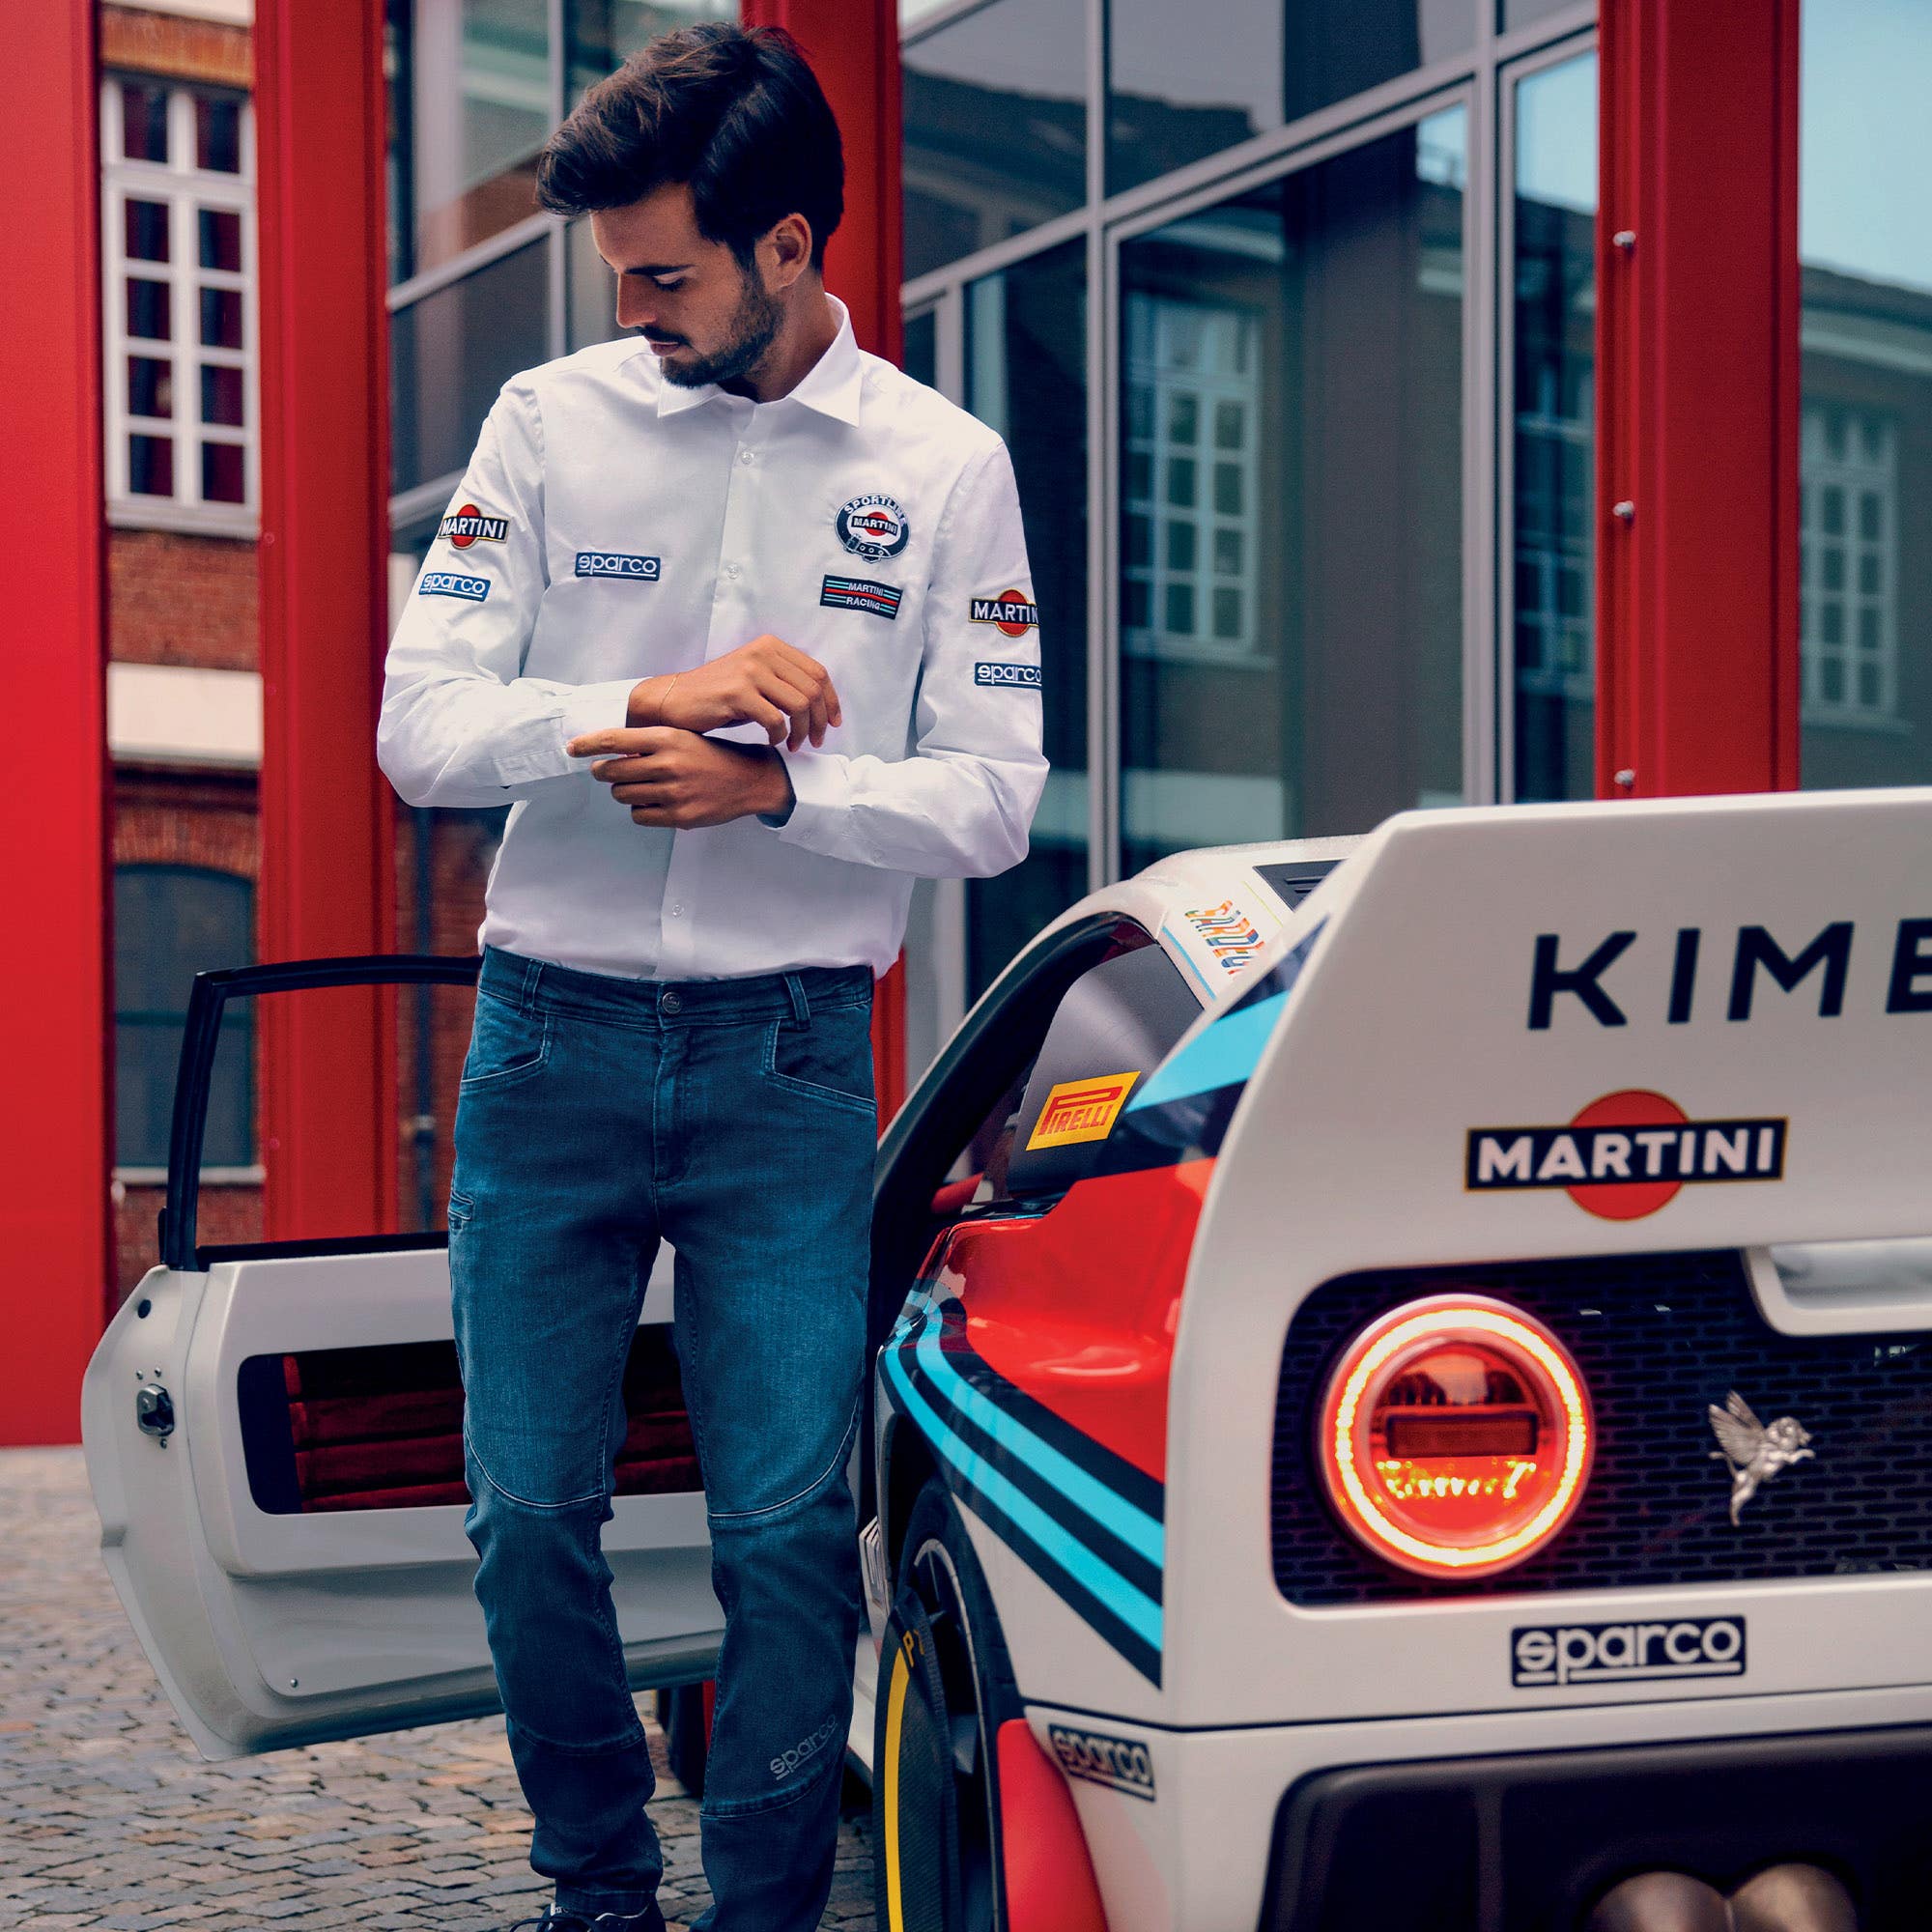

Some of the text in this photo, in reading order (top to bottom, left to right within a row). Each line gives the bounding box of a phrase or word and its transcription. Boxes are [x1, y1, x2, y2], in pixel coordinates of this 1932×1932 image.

[843, 495, 907, 527] SPORTLINE
[440, 517, 505, 539] MARTINI
[853, 517, 898, 534] MARTINI
[578, 554, 658, 575] sparco
[423, 574, 486, 595] sparco
[848, 582, 884, 597] MARTINI
[846, 597, 881, 611] RACING
[978, 664, 1041, 685] sparco
[1184, 899, 1264, 976] SARDEG
[1037, 1086, 1123, 1136] PIRELLI
[1477, 1127, 1776, 1182] MARTINI
[1516, 1620, 1742, 1685] sparco
[770, 1714, 836, 1774] sparco
[1053, 1731, 1153, 1784] sparco
